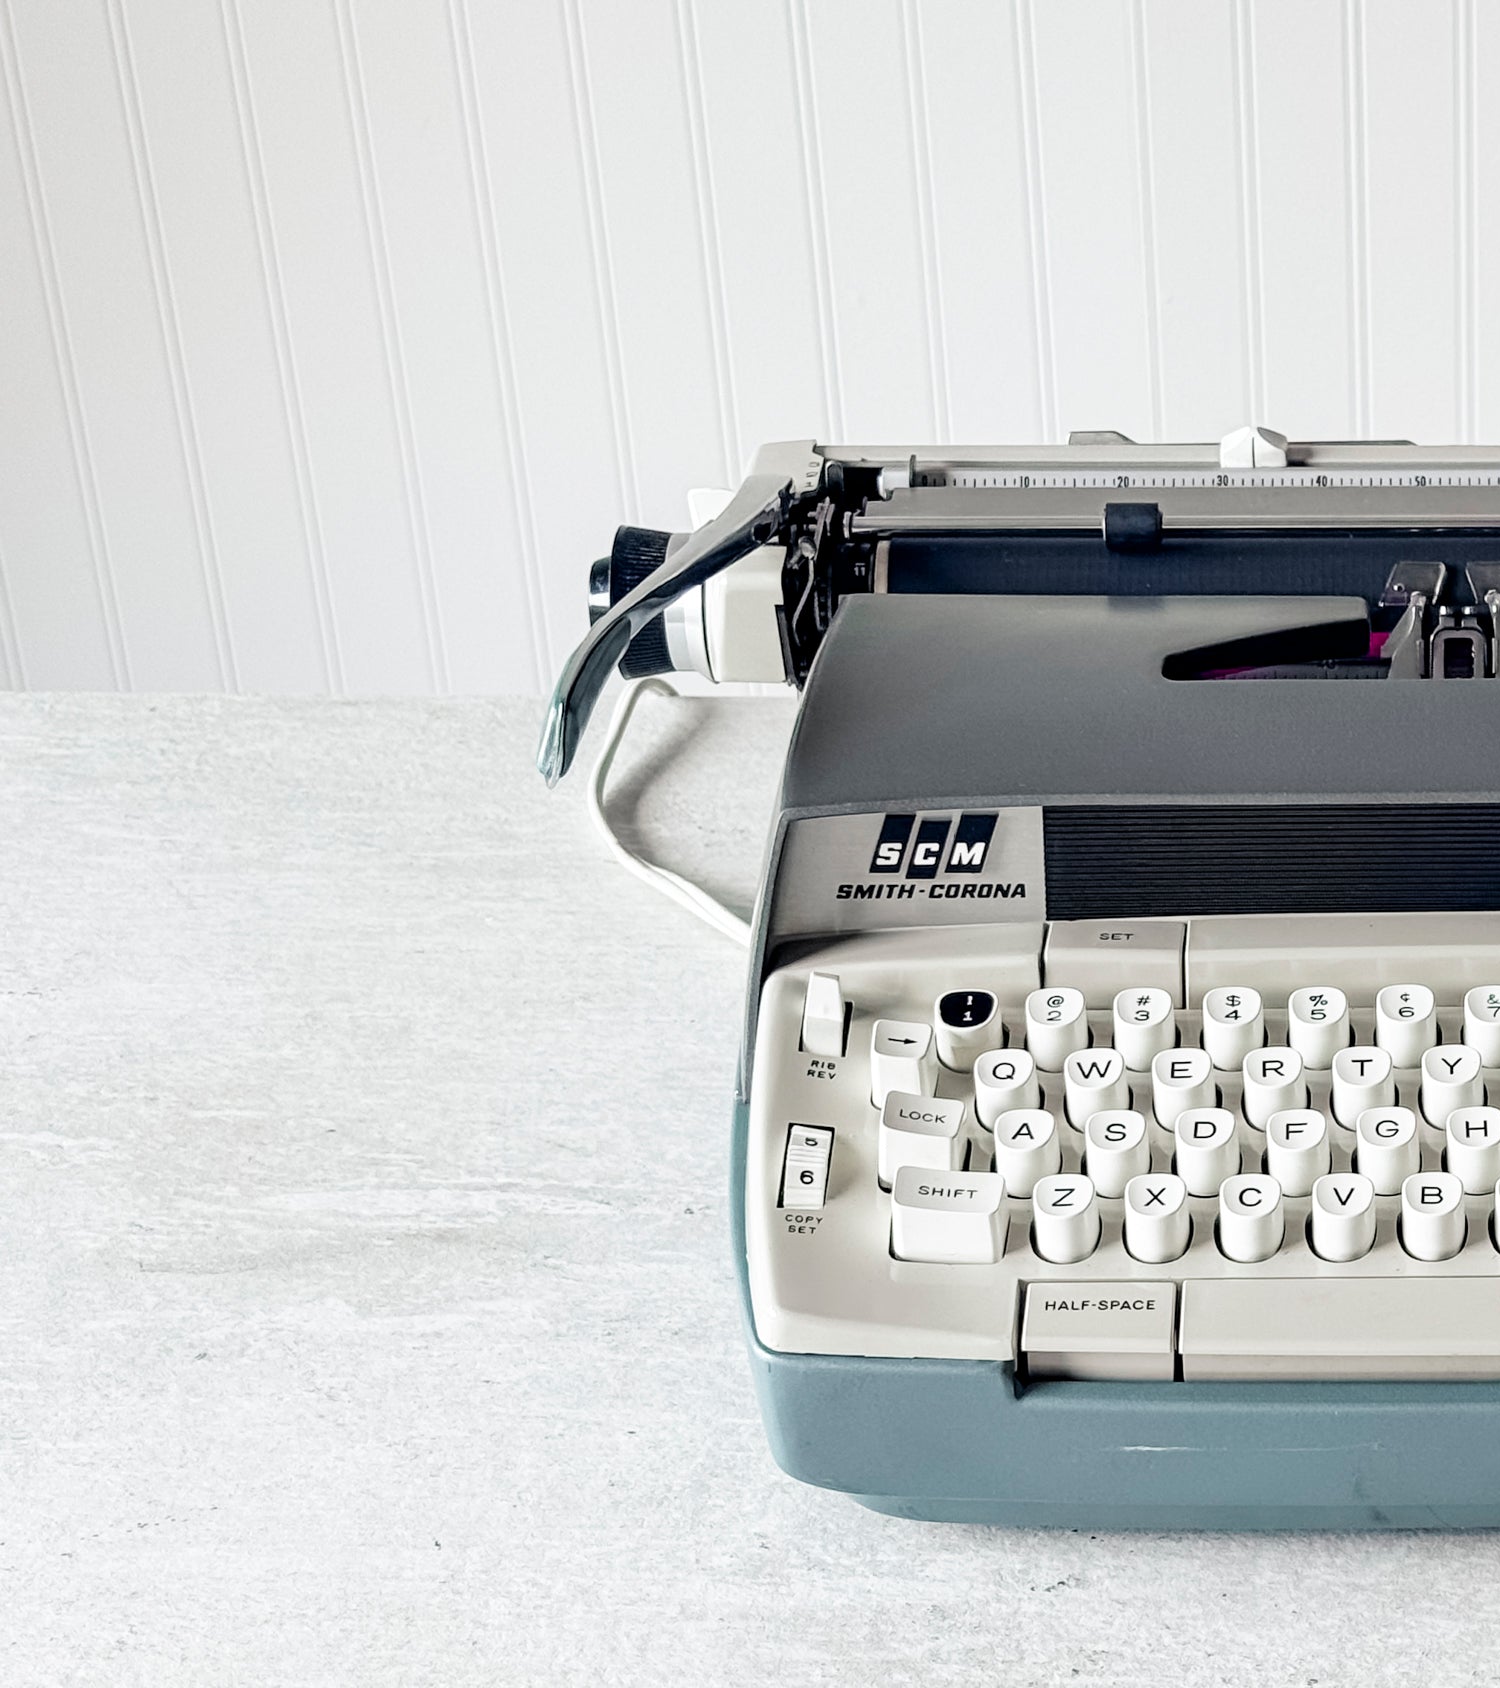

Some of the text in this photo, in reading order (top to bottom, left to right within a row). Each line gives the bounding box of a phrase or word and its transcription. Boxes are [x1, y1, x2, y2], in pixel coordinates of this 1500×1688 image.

[1117, 474, 1129, 489] 20
[1216, 474, 1229, 487] 30
[1315, 474, 1328, 487] 40
[1414, 474, 1427, 487] 50
[875, 842, 987, 866] SCM
[835, 883, 1026, 900] SMITH-CORONA
[1099, 932, 1135, 941] SET
[1046, 1010, 1062, 1022] 2
[1133, 1009, 1150, 1022] 3
[1224, 1009, 1242, 1021] 4
[1310, 1008, 1327, 1021] 5
[1398, 1006, 1415, 1018] 6
[806, 1068, 837, 1080] REV
[991, 1062, 1016, 1080] Q
[1076, 1059, 1112, 1080] W
[1170, 1060, 1193, 1079] E
[1262, 1059, 1285, 1078] R
[1351, 1058, 1374, 1077] T
[1441, 1057, 1463, 1075] Y
[898, 1107, 946, 1124] LOCK
[1011, 1122, 1035, 1140] A
[1104, 1123, 1127, 1142] S
[1193, 1121, 1217, 1139] D
[1285, 1122, 1308, 1141] F
[1375, 1119, 1400, 1138] G
[1465, 1120, 1488, 1139] H
[804, 1136, 819, 1147] 5
[799, 1170, 814, 1185] 6
[917, 1185, 978, 1199] SHIFT
[1051, 1188, 1076, 1207] Z
[1143, 1187, 1166, 1207] X
[1238, 1187, 1262, 1208] C
[1332, 1187, 1355, 1206] V
[1420, 1186, 1444, 1205] B
[784, 1213, 824, 1225] COPY
[1044, 1299, 1156, 1311] HALF-SPACE
